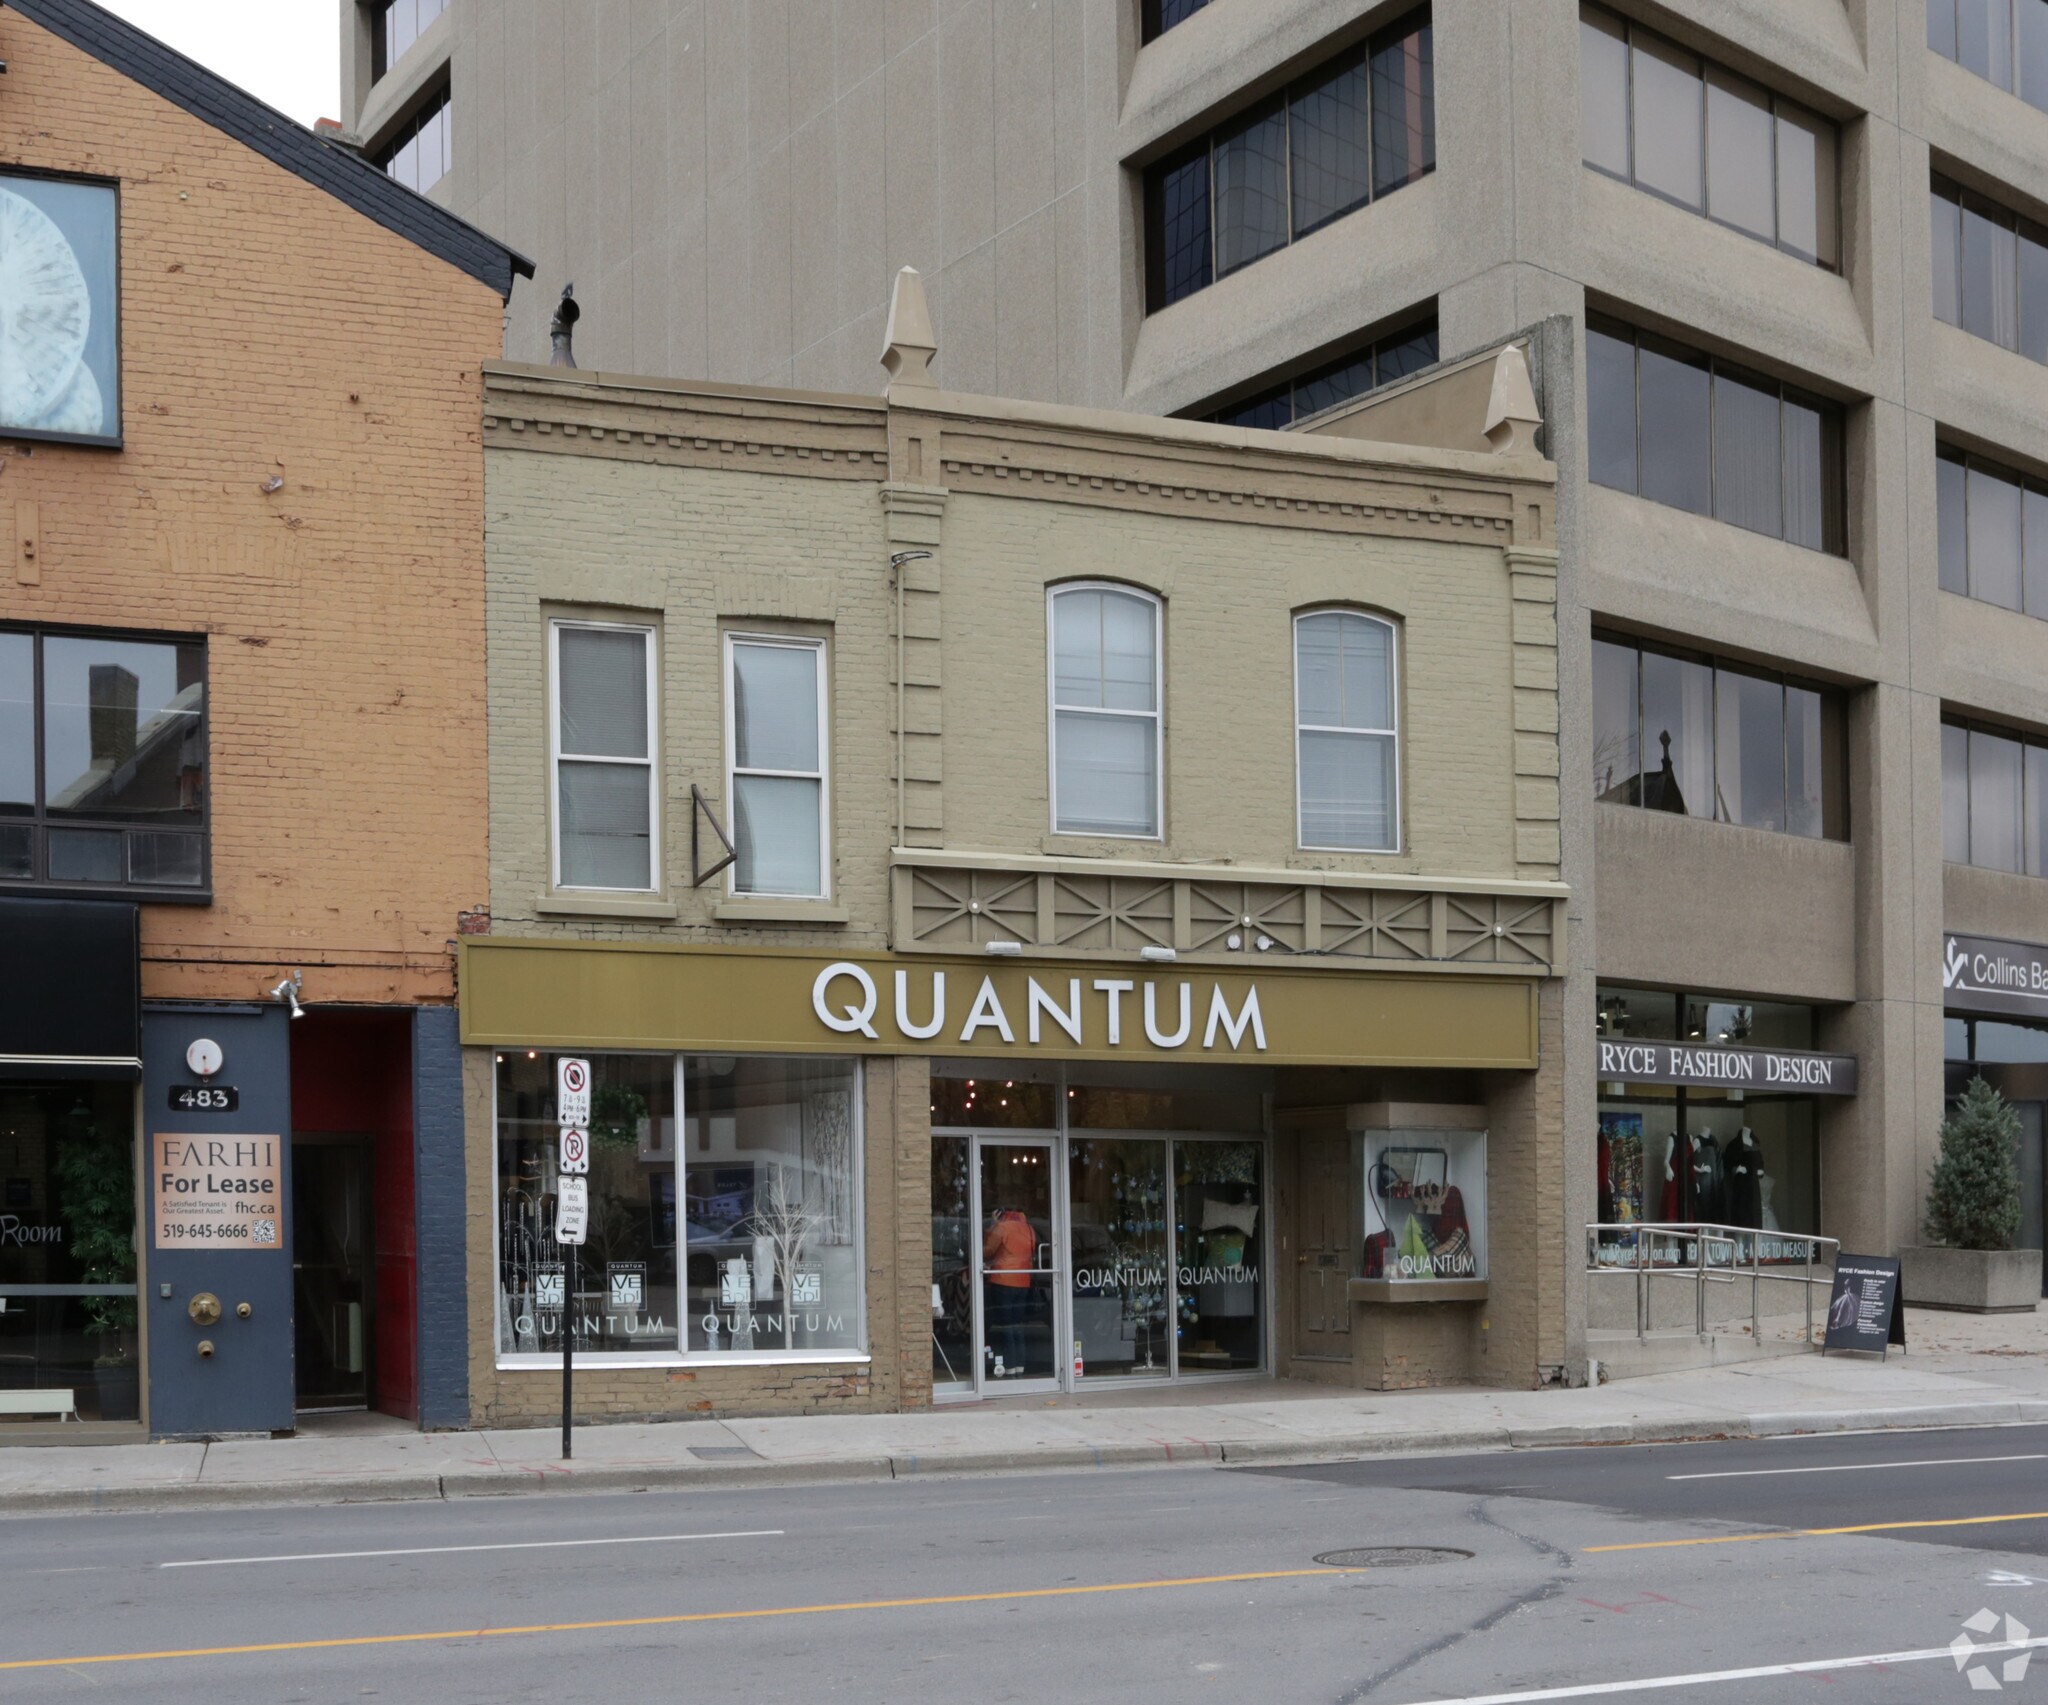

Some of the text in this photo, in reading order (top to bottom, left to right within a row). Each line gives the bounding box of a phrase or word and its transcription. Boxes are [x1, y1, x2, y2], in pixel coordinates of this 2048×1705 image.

[1974, 953, 2027, 988] Collins
[812, 962, 1267, 1050] QUANTUM
[1600, 1043, 1833, 1085] RYCE FASHION DESIGN
[178, 1089, 229, 1108] 483
[162, 1141, 274, 1168] FARHI
[161, 1173, 275, 1194] For Lease
[562, 1182, 583, 1191] SCHOOL
[169, 1200, 197, 1208] Satisfied
[235, 1201, 275, 1214] fhc.ca
[568, 1194, 578, 1202] BUS
[176, 1207, 205, 1215] Greatest
[562, 1205, 584, 1214] LOADING
[565, 1216, 580, 1224] ZONE
[0, 1214, 62, 1248] Room
[163, 1224, 248, 1239] 519-645-6666
[1782, 1241, 1816, 1258] MEASUE
[1400, 1254, 1475, 1274] QUANTUM
[1875, 1269, 1895, 1277] Design
[1076, 1268, 1162, 1289] QUANTUM
[1178, 1265, 1259, 1285] QUANTUM
[515, 1315, 665, 1336] QUNTUM
[701, 1314, 844, 1334] QUANTUM
